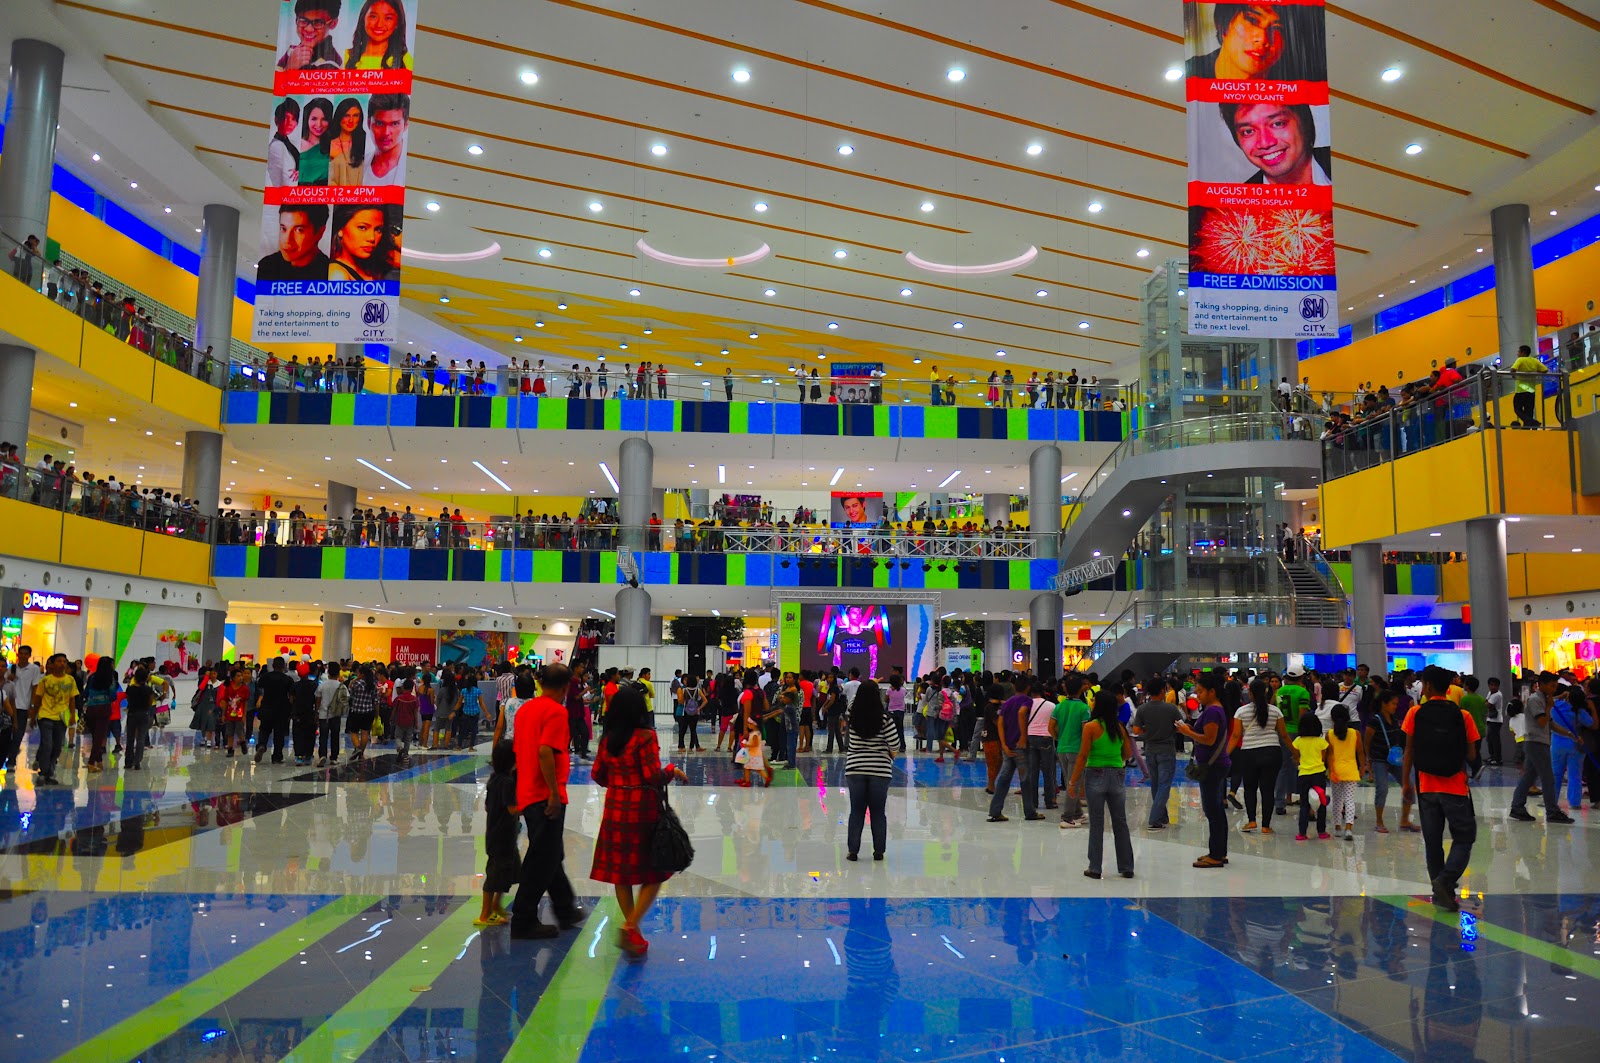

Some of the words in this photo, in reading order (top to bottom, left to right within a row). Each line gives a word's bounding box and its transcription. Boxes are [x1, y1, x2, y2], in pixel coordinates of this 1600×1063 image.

[299, 72, 339, 80] AUGUST
[361, 71, 384, 80] 4PM
[1210, 82, 1251, 91] AUGUST
[1255, 83, 1266, 92] 12
[1276, 83, 1298, 92] 7PM
[289, 188, 329, 196] AUGUST
[333, 188, 344, 196] 12
[353, 188, 375, 196] 4PM
[1206, 186, 1248, 196] AUGUST
[1251, 187, 1263, 196] 10
[1273, 188, 1284, 196] 11
[1295, 188, 1307, 197] 12
[1220, 197, 1260, 206] FIREWORS
[1262, 198, 1293, 206] DISPLAY
[1203, 274, 1237, 288] FREE
[1241, 275, 1324, 290] ADMISSION
[270, 282, 303, 294] FREE
[306, 281, 386, 295] ADMISSION
[1195, 301, 1220, 311] Taking
[1222, 303, 1262, 313] shopping,
[1263, 304, 1289, 313] dining
[1302, 297, 1324, 319] SM
[259, 309, 284, 319] Taking
[286, 309, 324, 319] shopping,
[326, 309, 351, 318] dining
[363, 302, 385, 324] SM
[1194, 312, 1209, 320] and
[1211, 314, 1267, 322] entertainment
[1194, 322, 1208, 330] the
[1229, 323, 1250, 331] level.
[1303, 324, 1326, 332] CITY
[291, 329, 312, 337] level.
[363, 329, 385, 337] CITY
[33, 593, 64, 610] Payless
[400, 645, 410, 653] AM
[396, 653, 419, 661] COTTON
[1013, 651, 1023, 663] G
